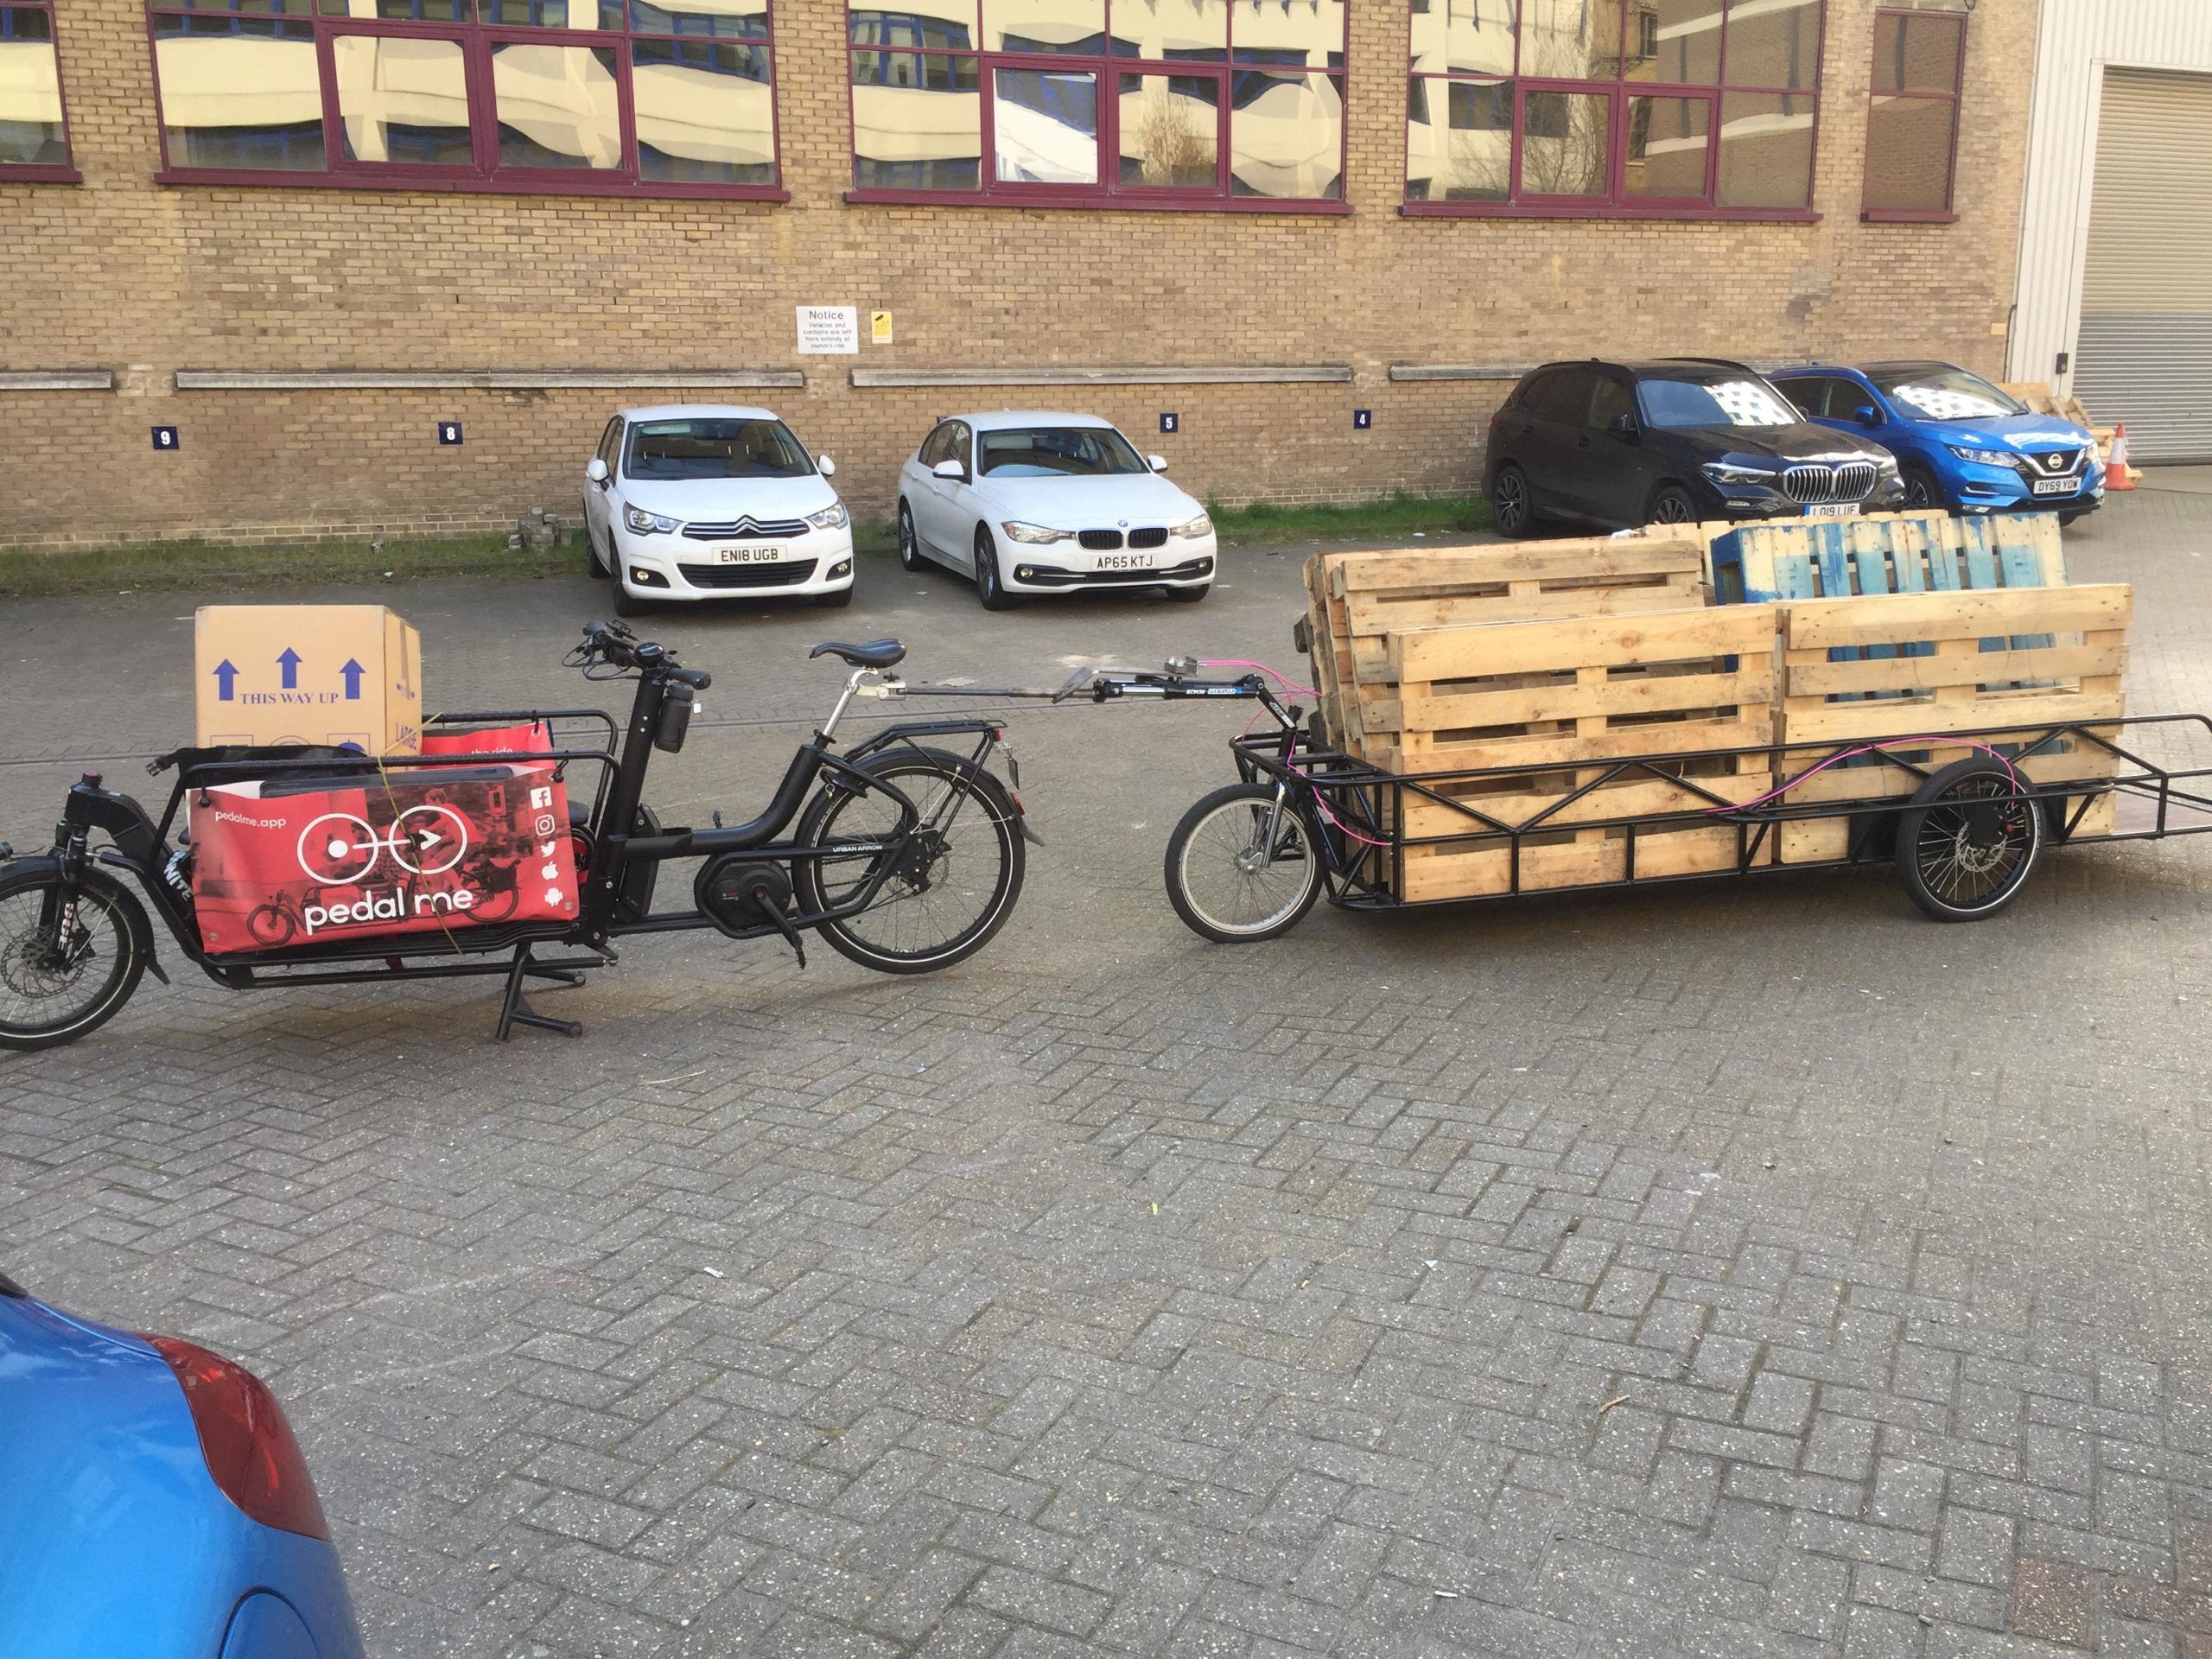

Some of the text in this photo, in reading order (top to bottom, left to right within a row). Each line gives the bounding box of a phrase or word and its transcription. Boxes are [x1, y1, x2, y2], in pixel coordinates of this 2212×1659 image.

[809, 310, 844, 320] Notice
[1166, 416, 1173, 429] 5
[1358, 414, 1366, 425] 4
[160, 430, 171, 445] 9
[446, 426, 455, 441] 8
[721, 548, 779, 562] EN18 UGB
[1096, 555, 1153, 569] AP65 KTJ
[239, 692, 340, 704] THIS WAY UP
[215, 810, 287, 830] pedalme.app
[304, 887, 474, 936] pedal me
